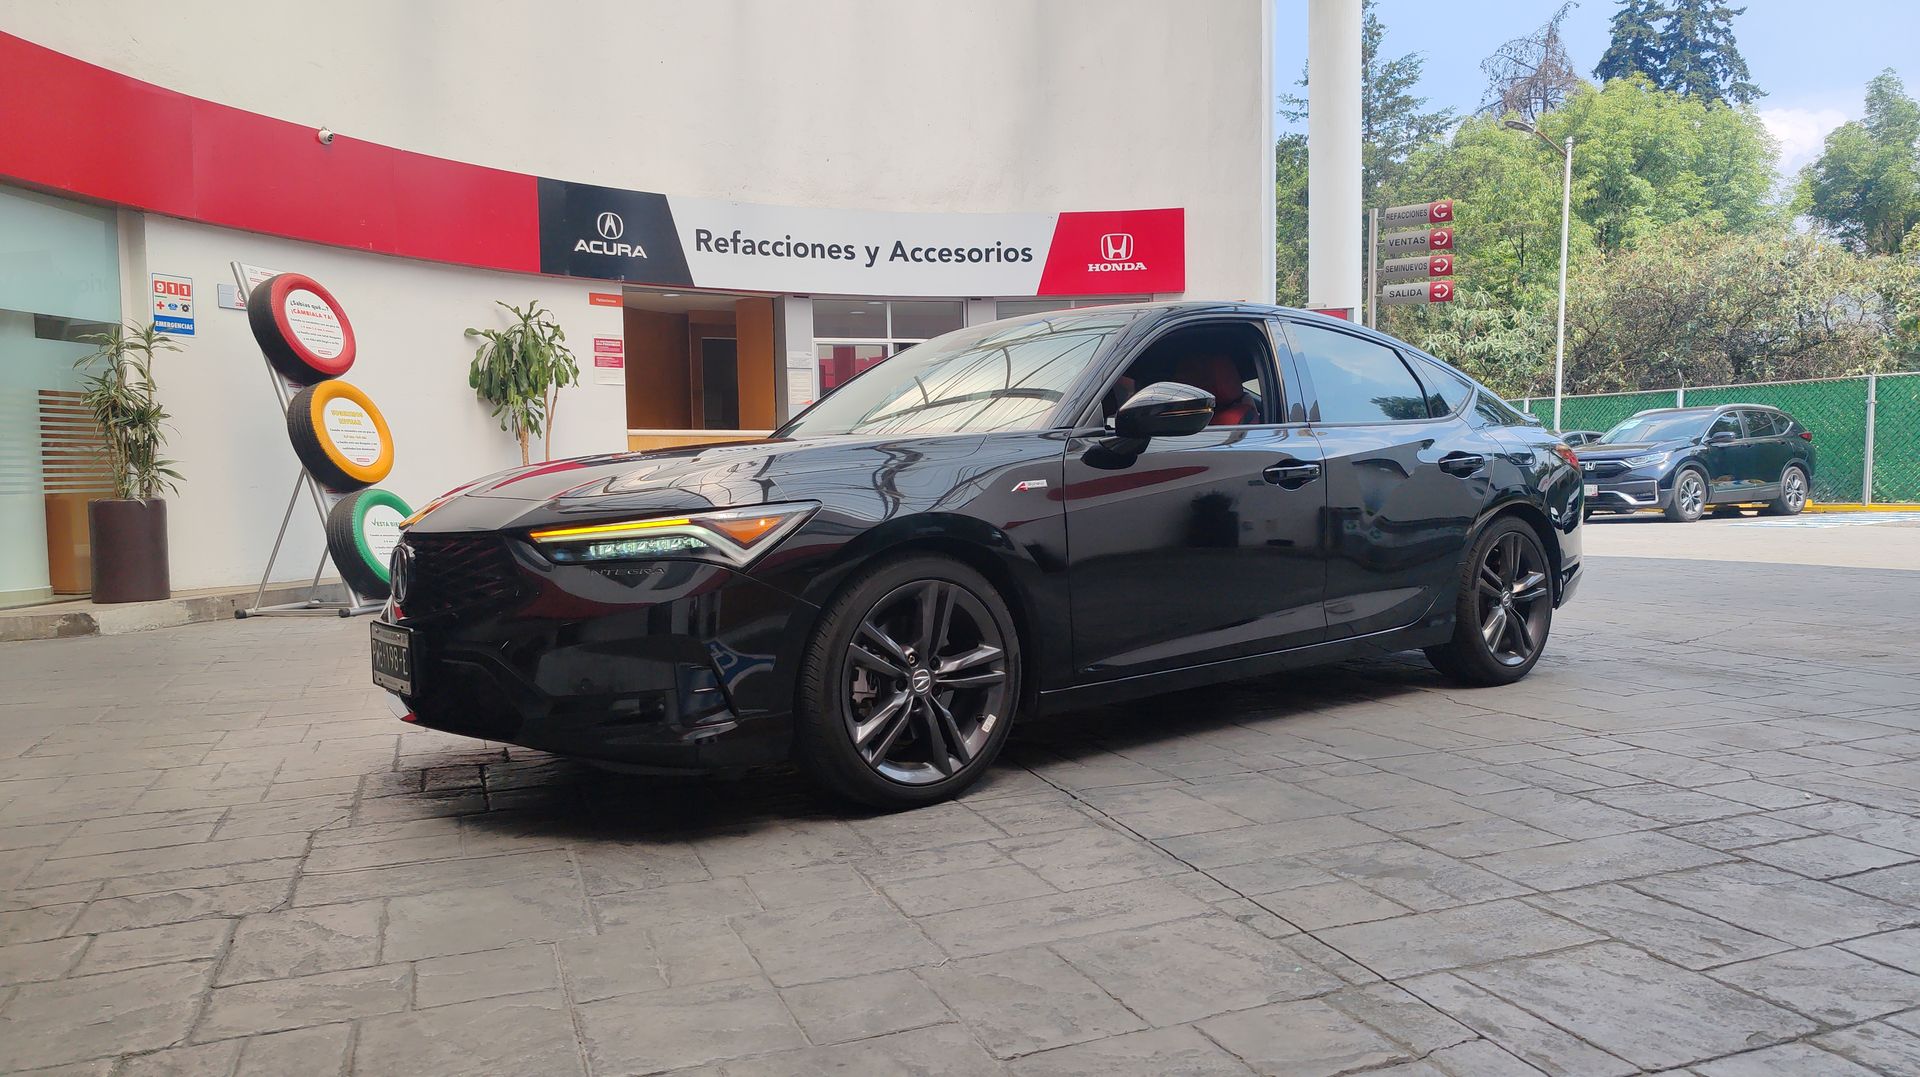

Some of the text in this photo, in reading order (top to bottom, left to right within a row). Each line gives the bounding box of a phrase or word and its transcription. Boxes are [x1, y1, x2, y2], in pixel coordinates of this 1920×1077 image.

[1386, 209, 1428, 221] REFACCIONES
[1389, 236, 1426, 247] VENTAS
[574, 239, 648, 259] ACURA
[695, 228, 1033, 268] Refacciones y Accesorios
[1087, 262, 1148, 272] HONDA
[1385, 262, 1428, 273] SEMINUEVOS
[1389, 288, 1423, 298] SALIDA
[155, 320, 193, 330] EMERGENCIAS
